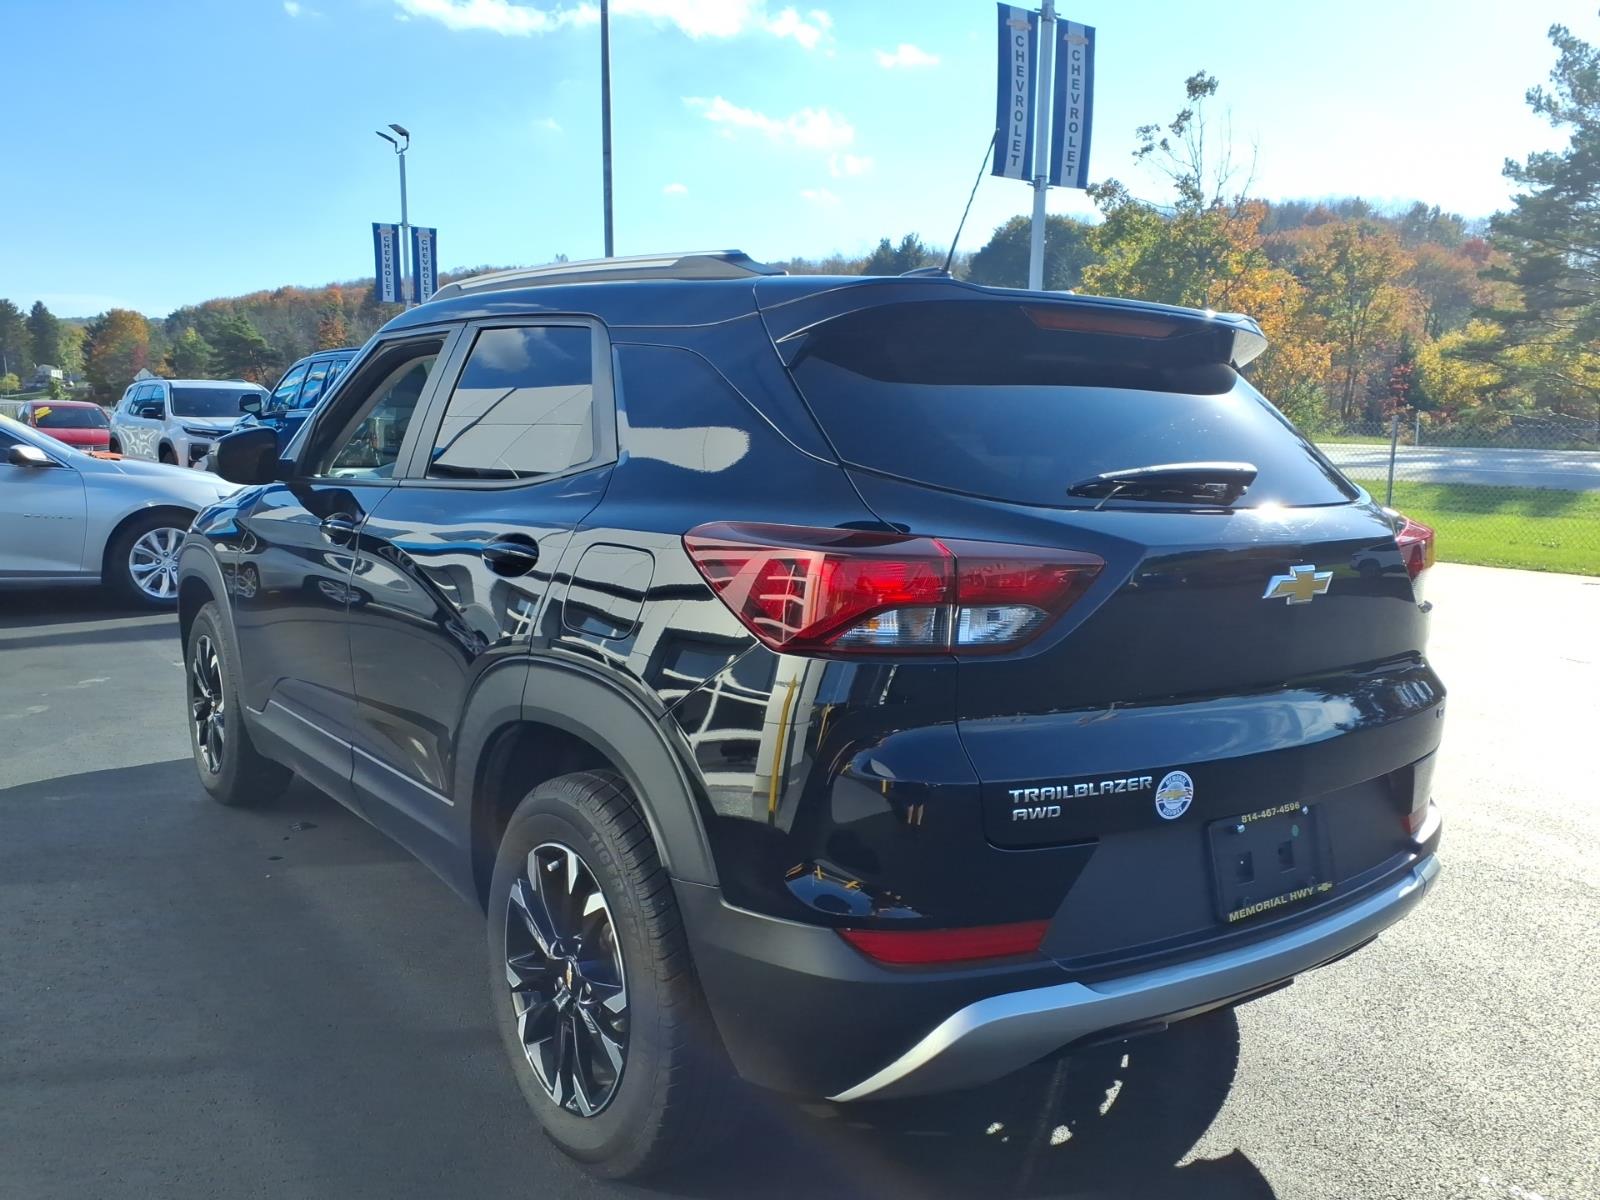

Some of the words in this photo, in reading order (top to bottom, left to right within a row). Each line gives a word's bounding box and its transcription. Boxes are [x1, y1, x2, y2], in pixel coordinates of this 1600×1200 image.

[1011, 35, 1025, 167] CHEVROLET
[1066, 50, 1081, 177] CHEVROLET
[383, 236, 392, 297] CHEVROLET
[421, 239, 430, 299] CHEVROLET
[1009, 776, 1153, 804] TRAILBLAZER
[1012, 805, 1062, 822] AWD
[1241, 801, 1300, 823] 814-467-4596
[1229, 895, 1288, 922] MEMORIAL
[1289, 886, 1315, 901] HWY
